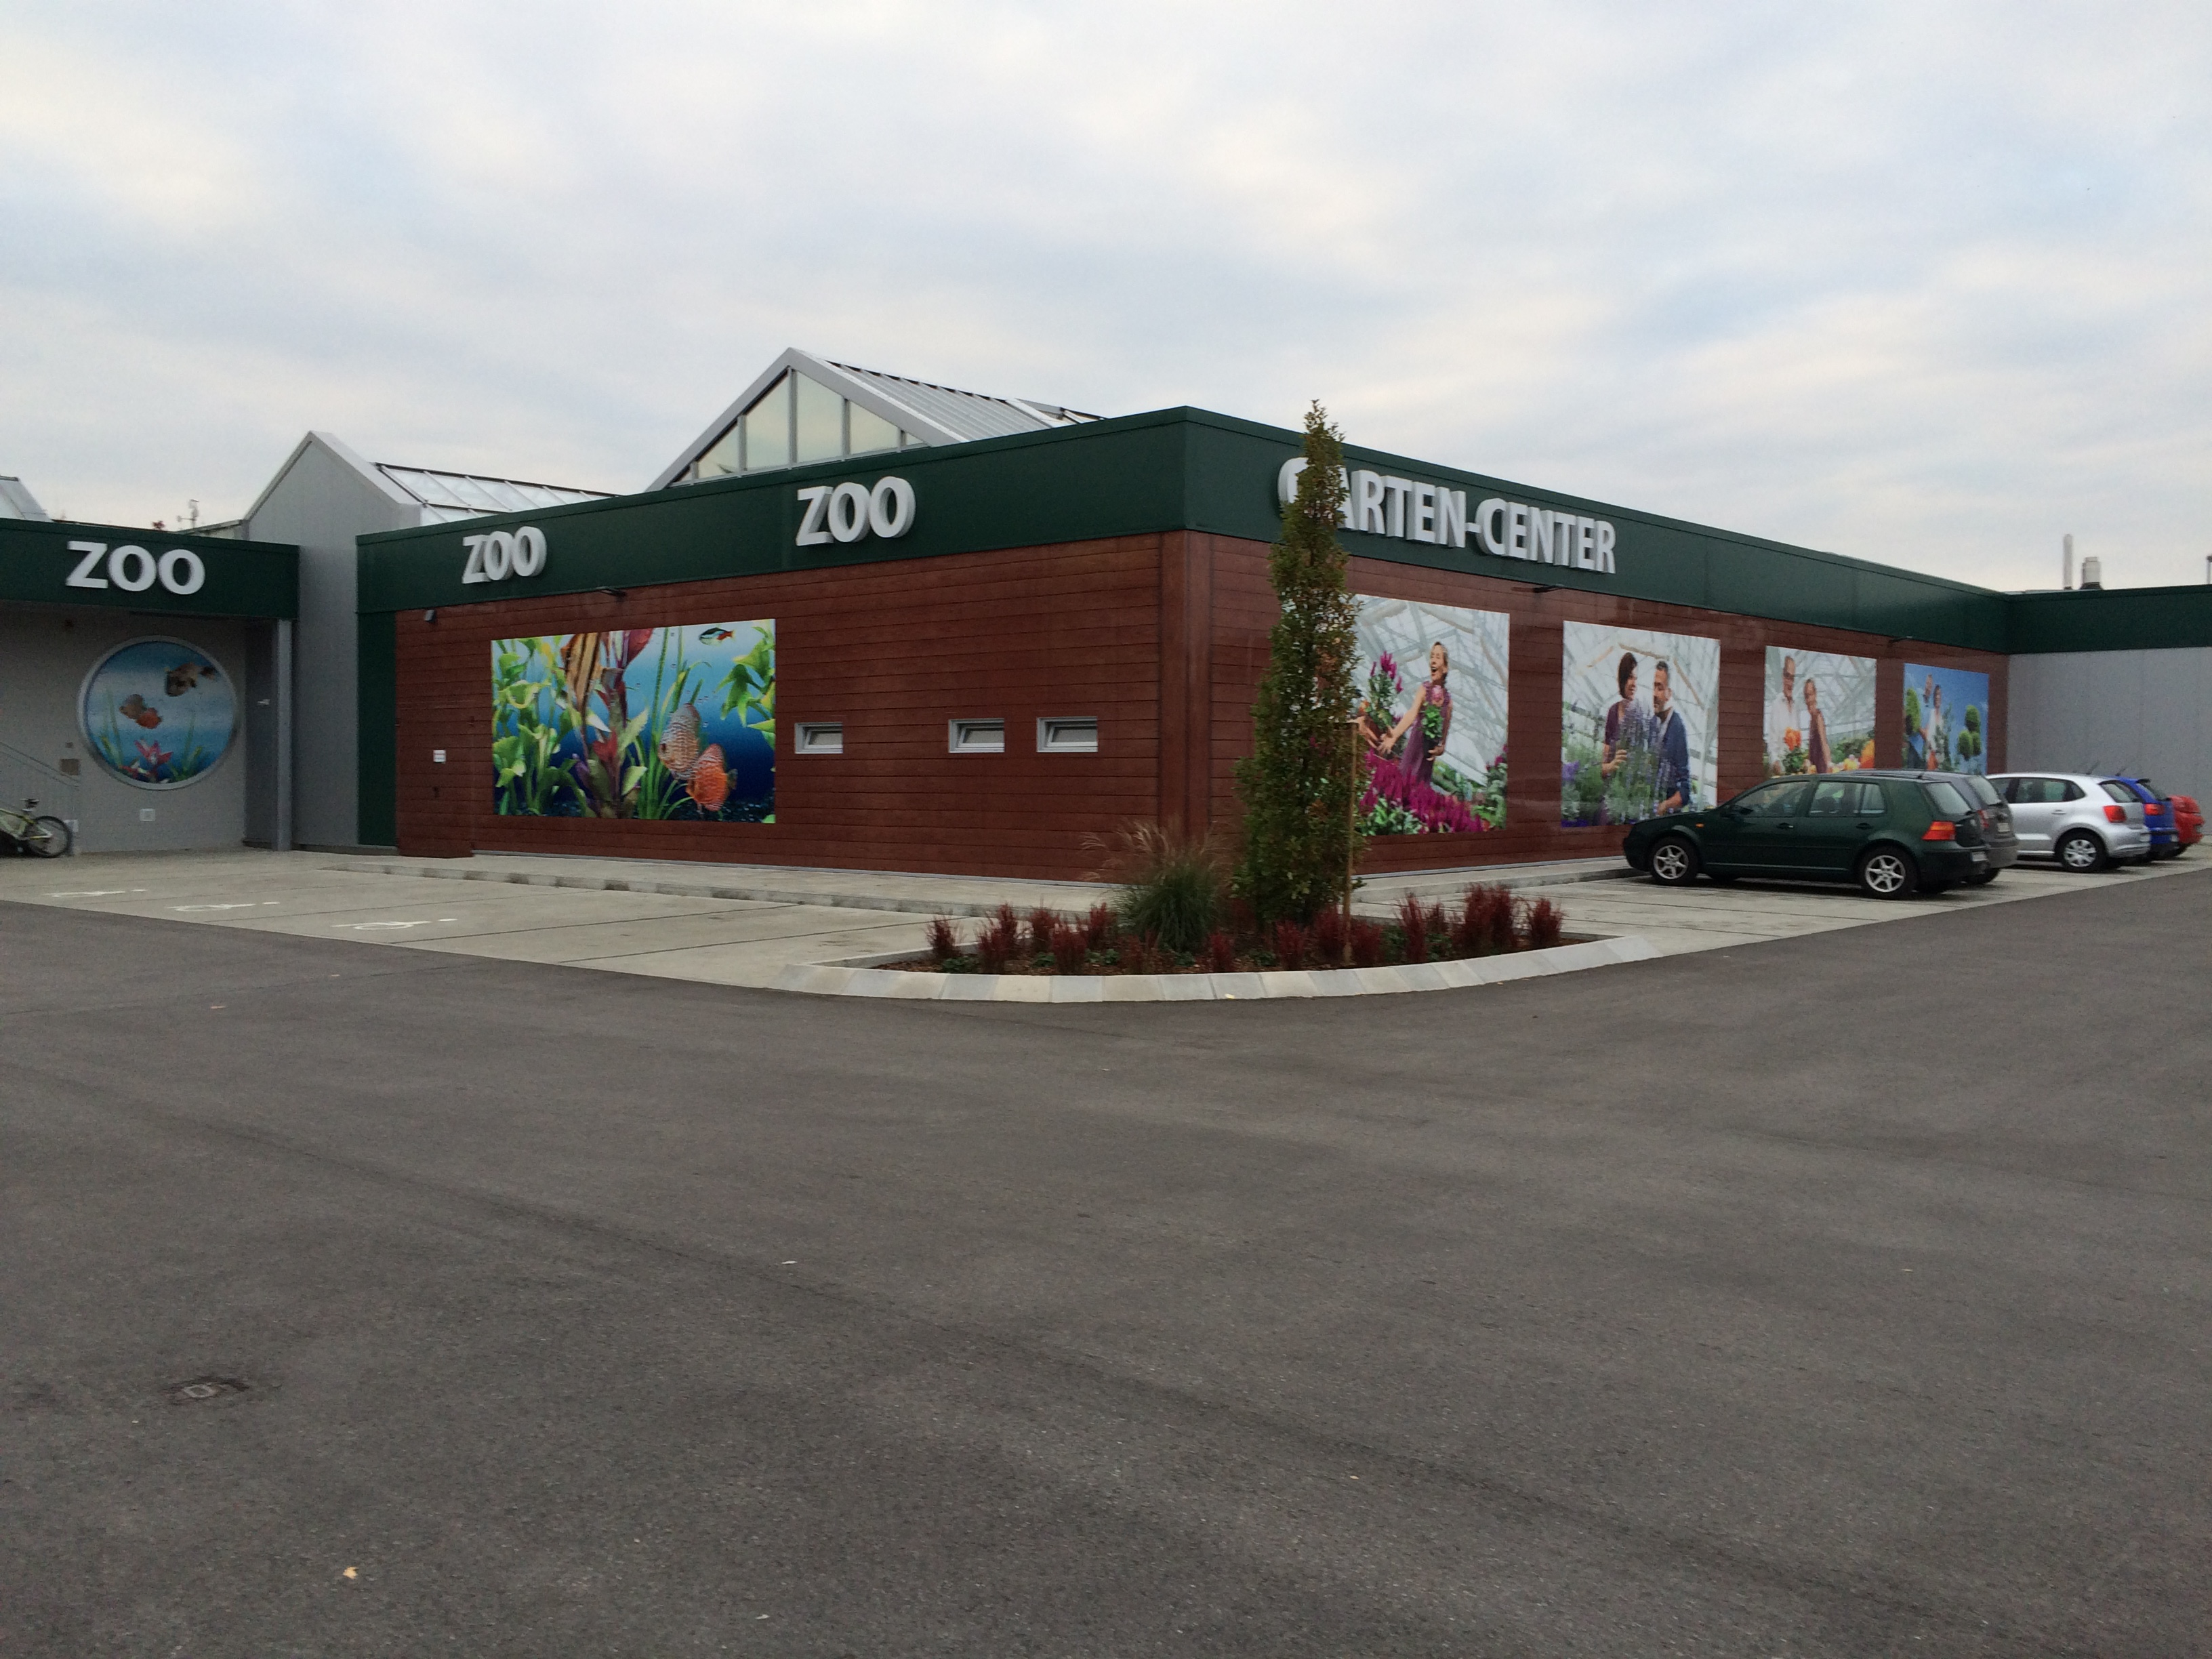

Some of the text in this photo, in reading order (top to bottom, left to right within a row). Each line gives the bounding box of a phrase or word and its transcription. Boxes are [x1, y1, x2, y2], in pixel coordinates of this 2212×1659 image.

[796, 476, 916, 546] ZOO
[66, 540, 206, 595] ZOO
[462, 526, 548, 584] ZOO
